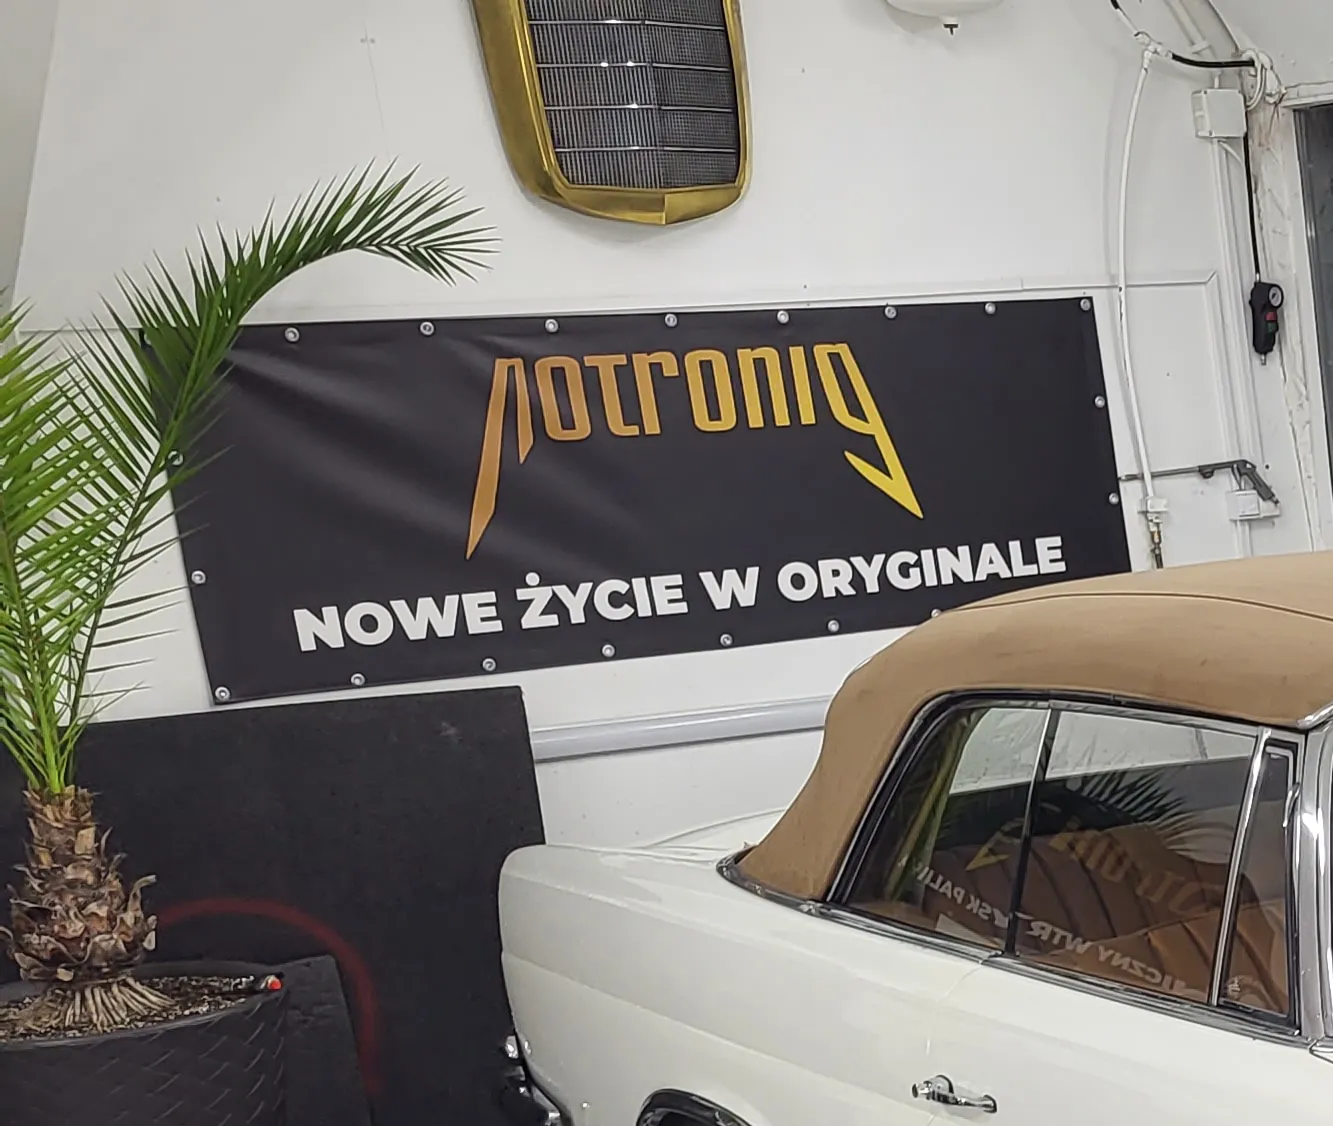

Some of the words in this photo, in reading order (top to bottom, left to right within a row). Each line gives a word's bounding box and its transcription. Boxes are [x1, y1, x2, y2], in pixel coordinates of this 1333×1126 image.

[293, 591, 503, 652] NOWE
[516, 572, 689, 629] ŻYCIE
[699, 567, 760, 610] W
[777, 536, 1067, 601] ORYGINALE
